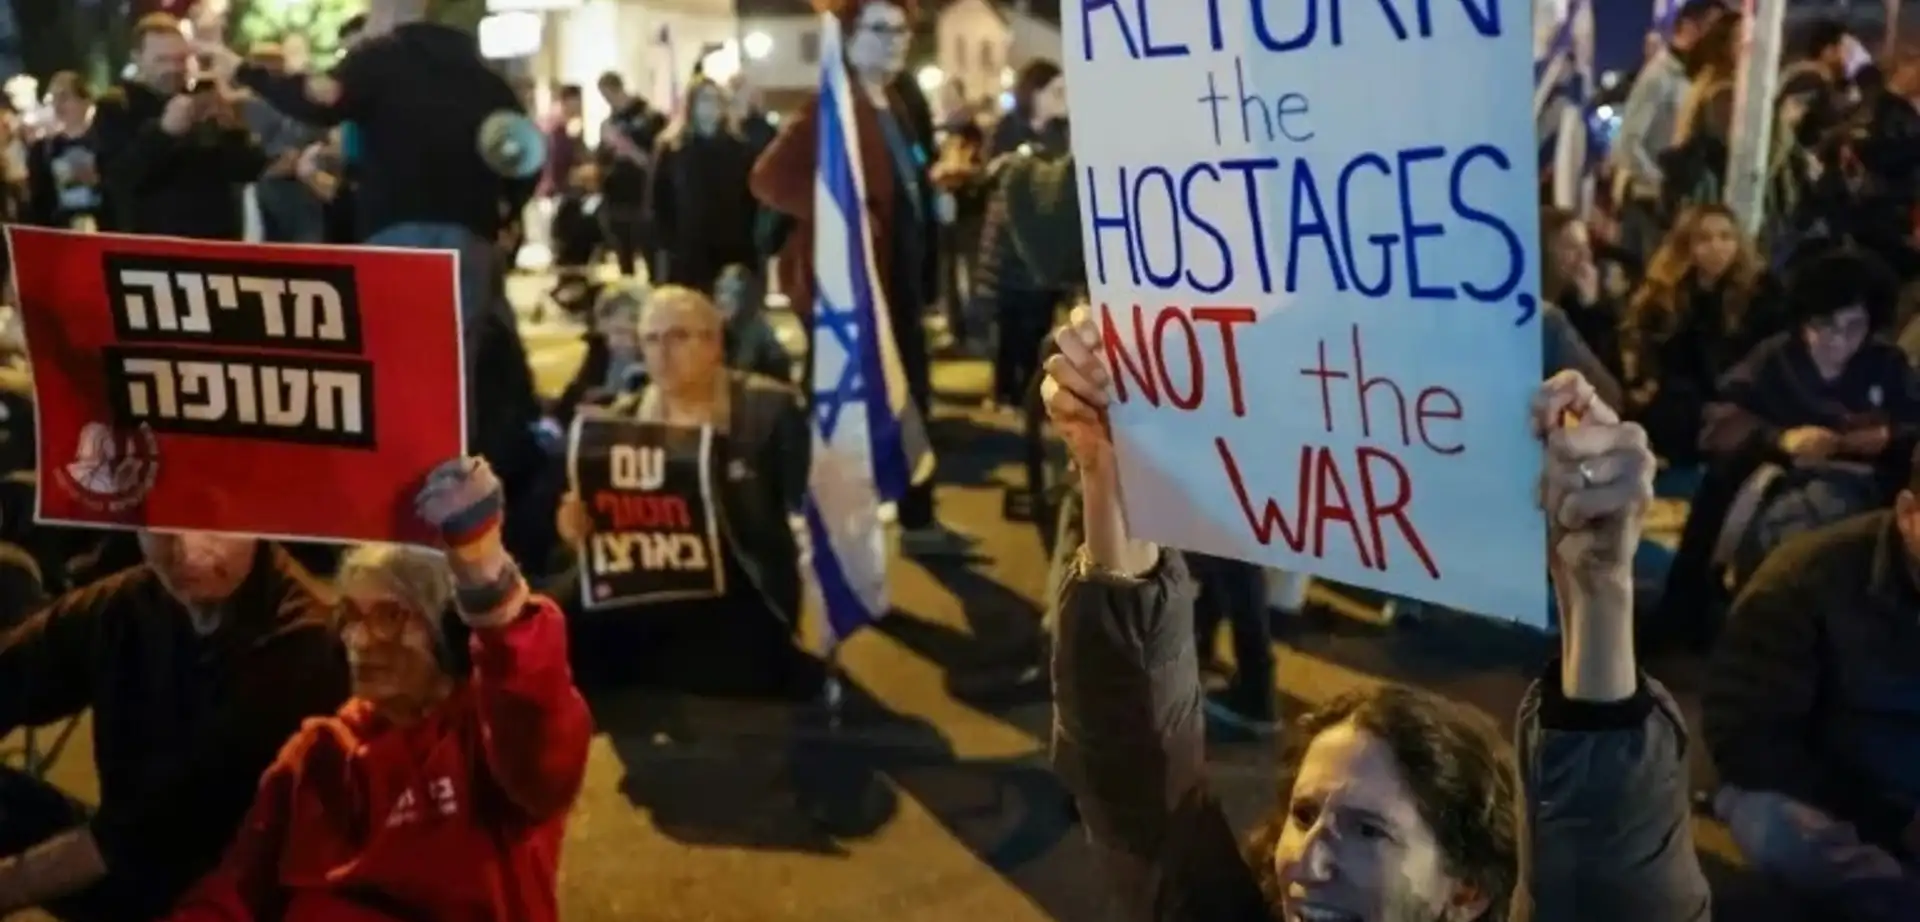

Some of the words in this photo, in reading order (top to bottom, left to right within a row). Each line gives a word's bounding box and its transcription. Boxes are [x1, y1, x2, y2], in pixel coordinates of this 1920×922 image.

[1198, 56, 1315, 145] the
[1088, 144, 1537, 326] HOSTAGES,
[120, 269, 346, 340] מדינה
[123, 358, 362, 433] חטופה
[1101, 303, 1257, 418] NOT
[1300, 323, 1465, 454] the
[610, 445, 665, 490] עם
[1215, 437, 1441, 580] WAR
[592, 533, 708, 575] בארצו
